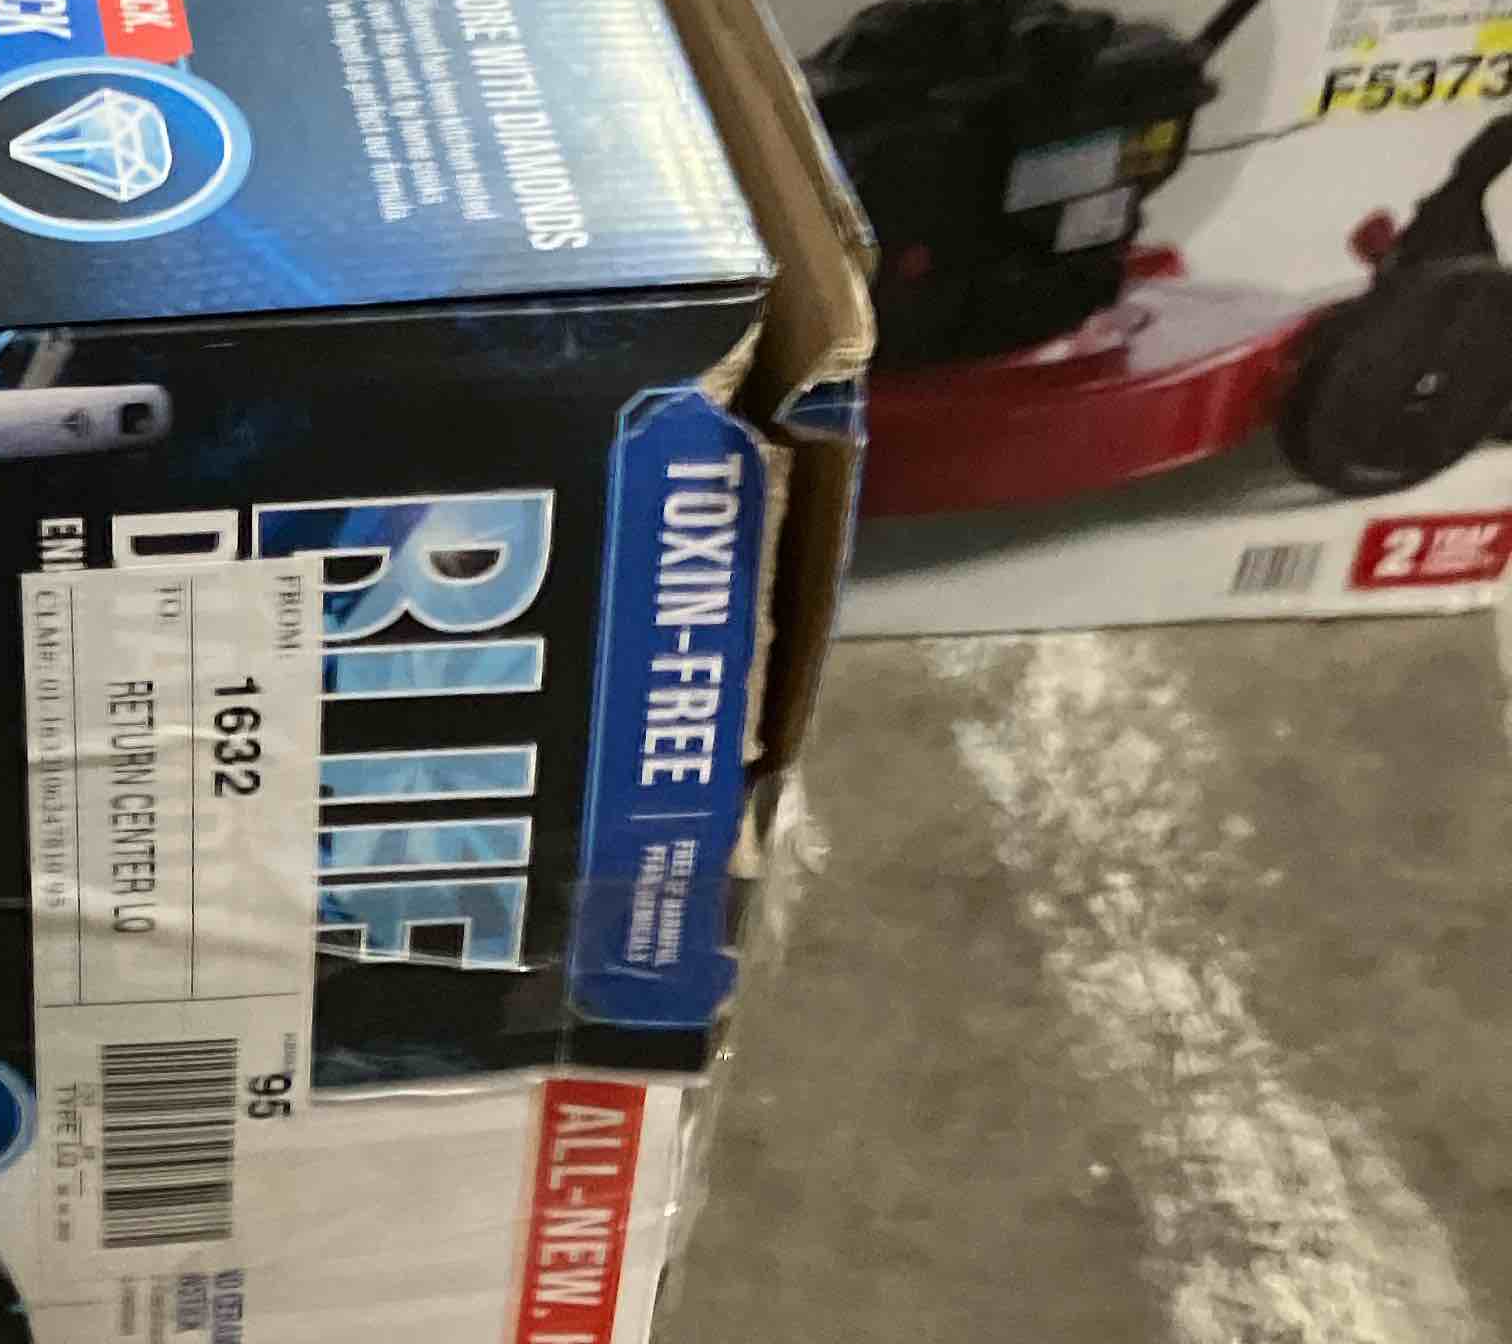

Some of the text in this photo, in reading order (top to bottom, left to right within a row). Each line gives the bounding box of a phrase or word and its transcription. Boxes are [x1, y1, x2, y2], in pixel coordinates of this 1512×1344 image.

[469, 45, 545, 108] WITH
[489, 111, 590, 251] DIAMONDS
[1371, 527, 1425, 578] 2
[640, 454, 744, 787] TOXIN-FREE
[108, 681, 159, 785] RETURN
[212, 676, 263, 797] 1632
[109, 793, 158, 894] CENTER
[247, 1074, 293, 1120] 95
[533, 1104, 626, 1318] ALL-NEW.
